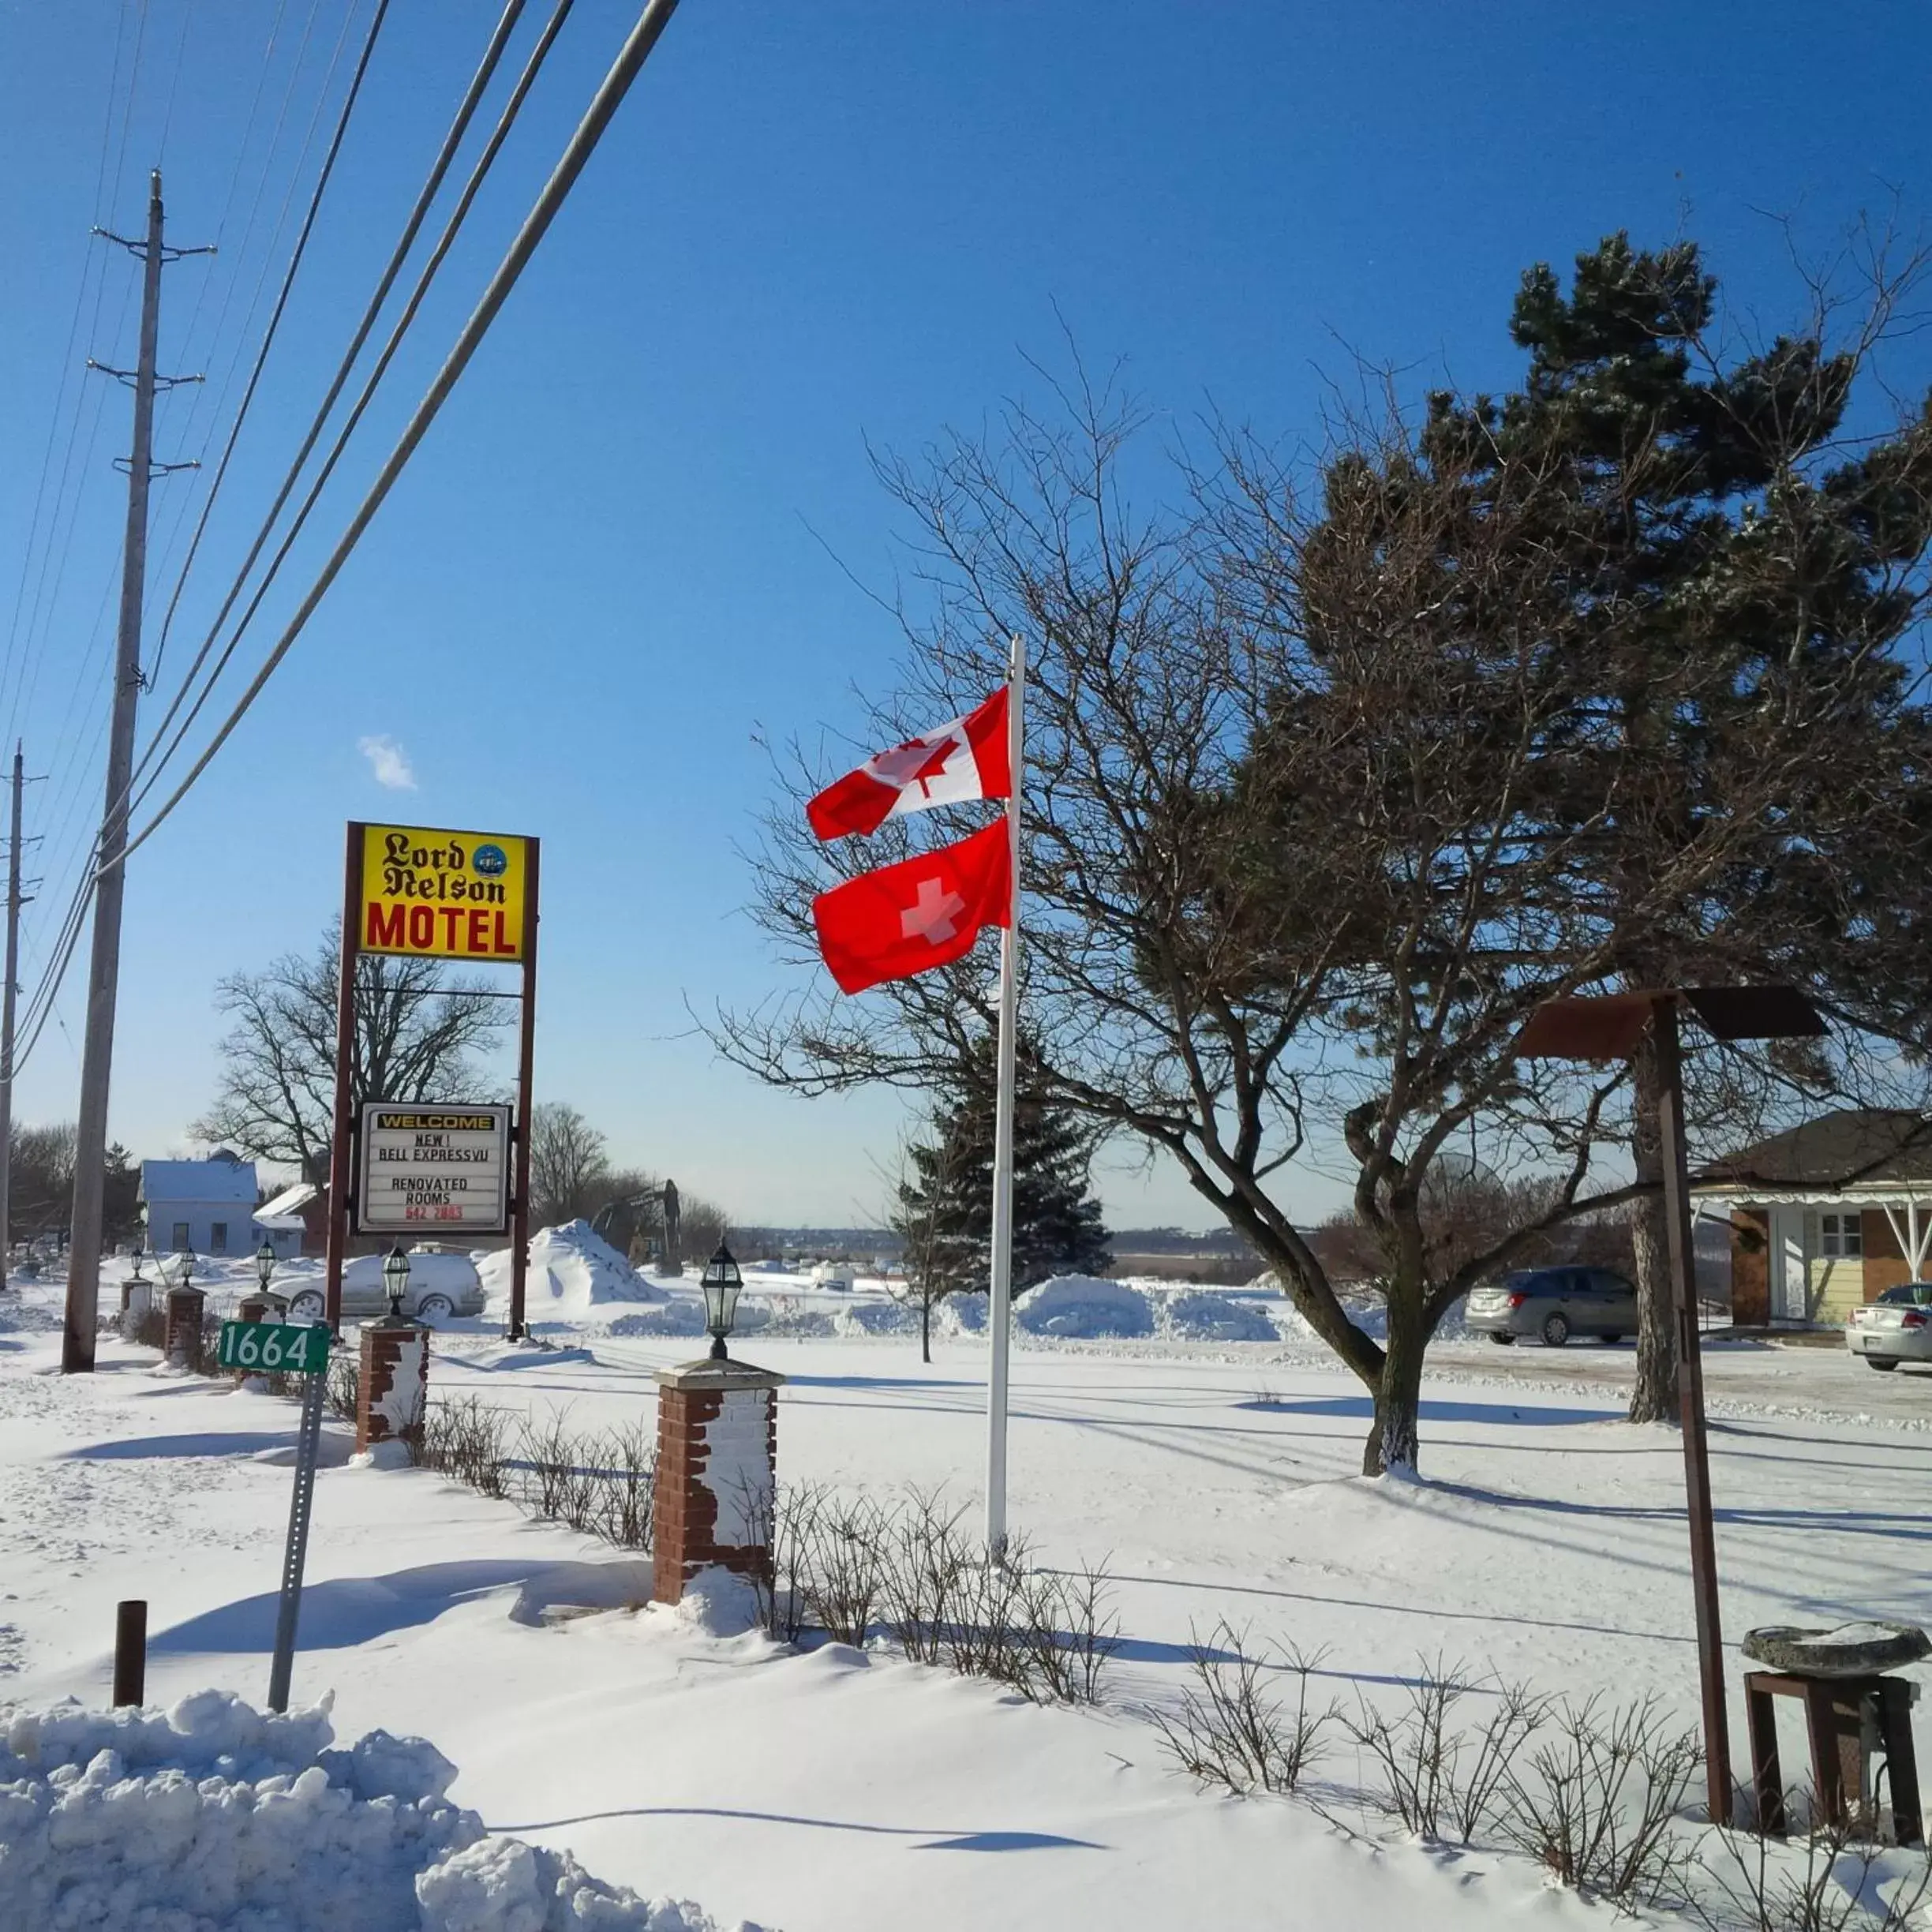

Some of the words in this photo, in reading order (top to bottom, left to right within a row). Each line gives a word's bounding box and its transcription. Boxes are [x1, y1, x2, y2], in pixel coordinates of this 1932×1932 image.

[382, 833, 465, 871] Lord
[382, 867, 507, 904] Nelson
[367, 902, 516, 954] MOTEL
[381, 1115, 492, 1129] WELCOME
[415, 1133, 450, 1147] NEW!
[379, 1148, 408, 1162] BELL
[414, 1148, 489, 1163] EXPRESSVU
[391, 1178, 468, 1191] RENOVATED
[406, 1192, 451, 1205] ROOMS
[224, 1325, 309, 1368] 1664
